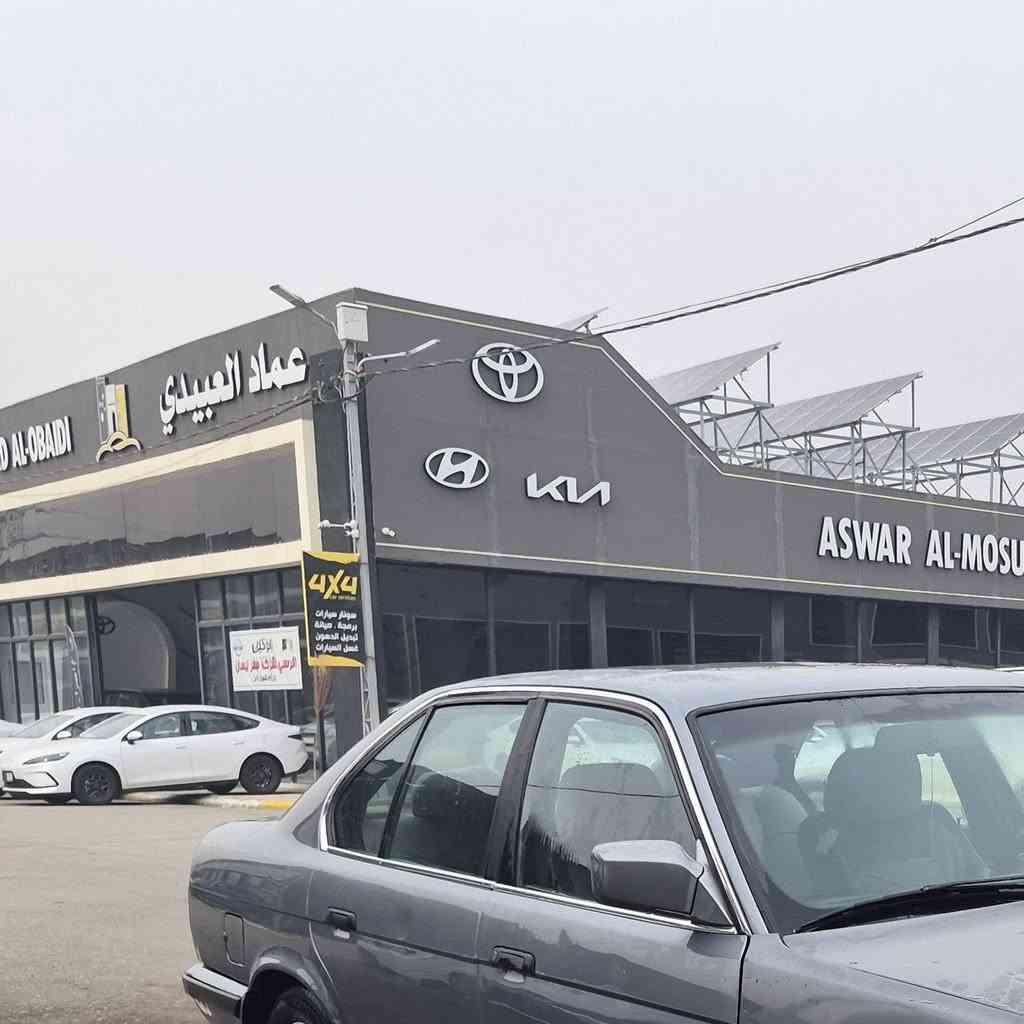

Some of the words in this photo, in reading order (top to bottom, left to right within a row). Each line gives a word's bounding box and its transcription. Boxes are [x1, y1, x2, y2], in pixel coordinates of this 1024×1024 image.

[160, 350, 241, 435] العبيدي
[249, 341, 306, 393] عماد
[12, 416, 72, 468] AL-OBAIDI
[818, 516, 911, 565] ASWAR
